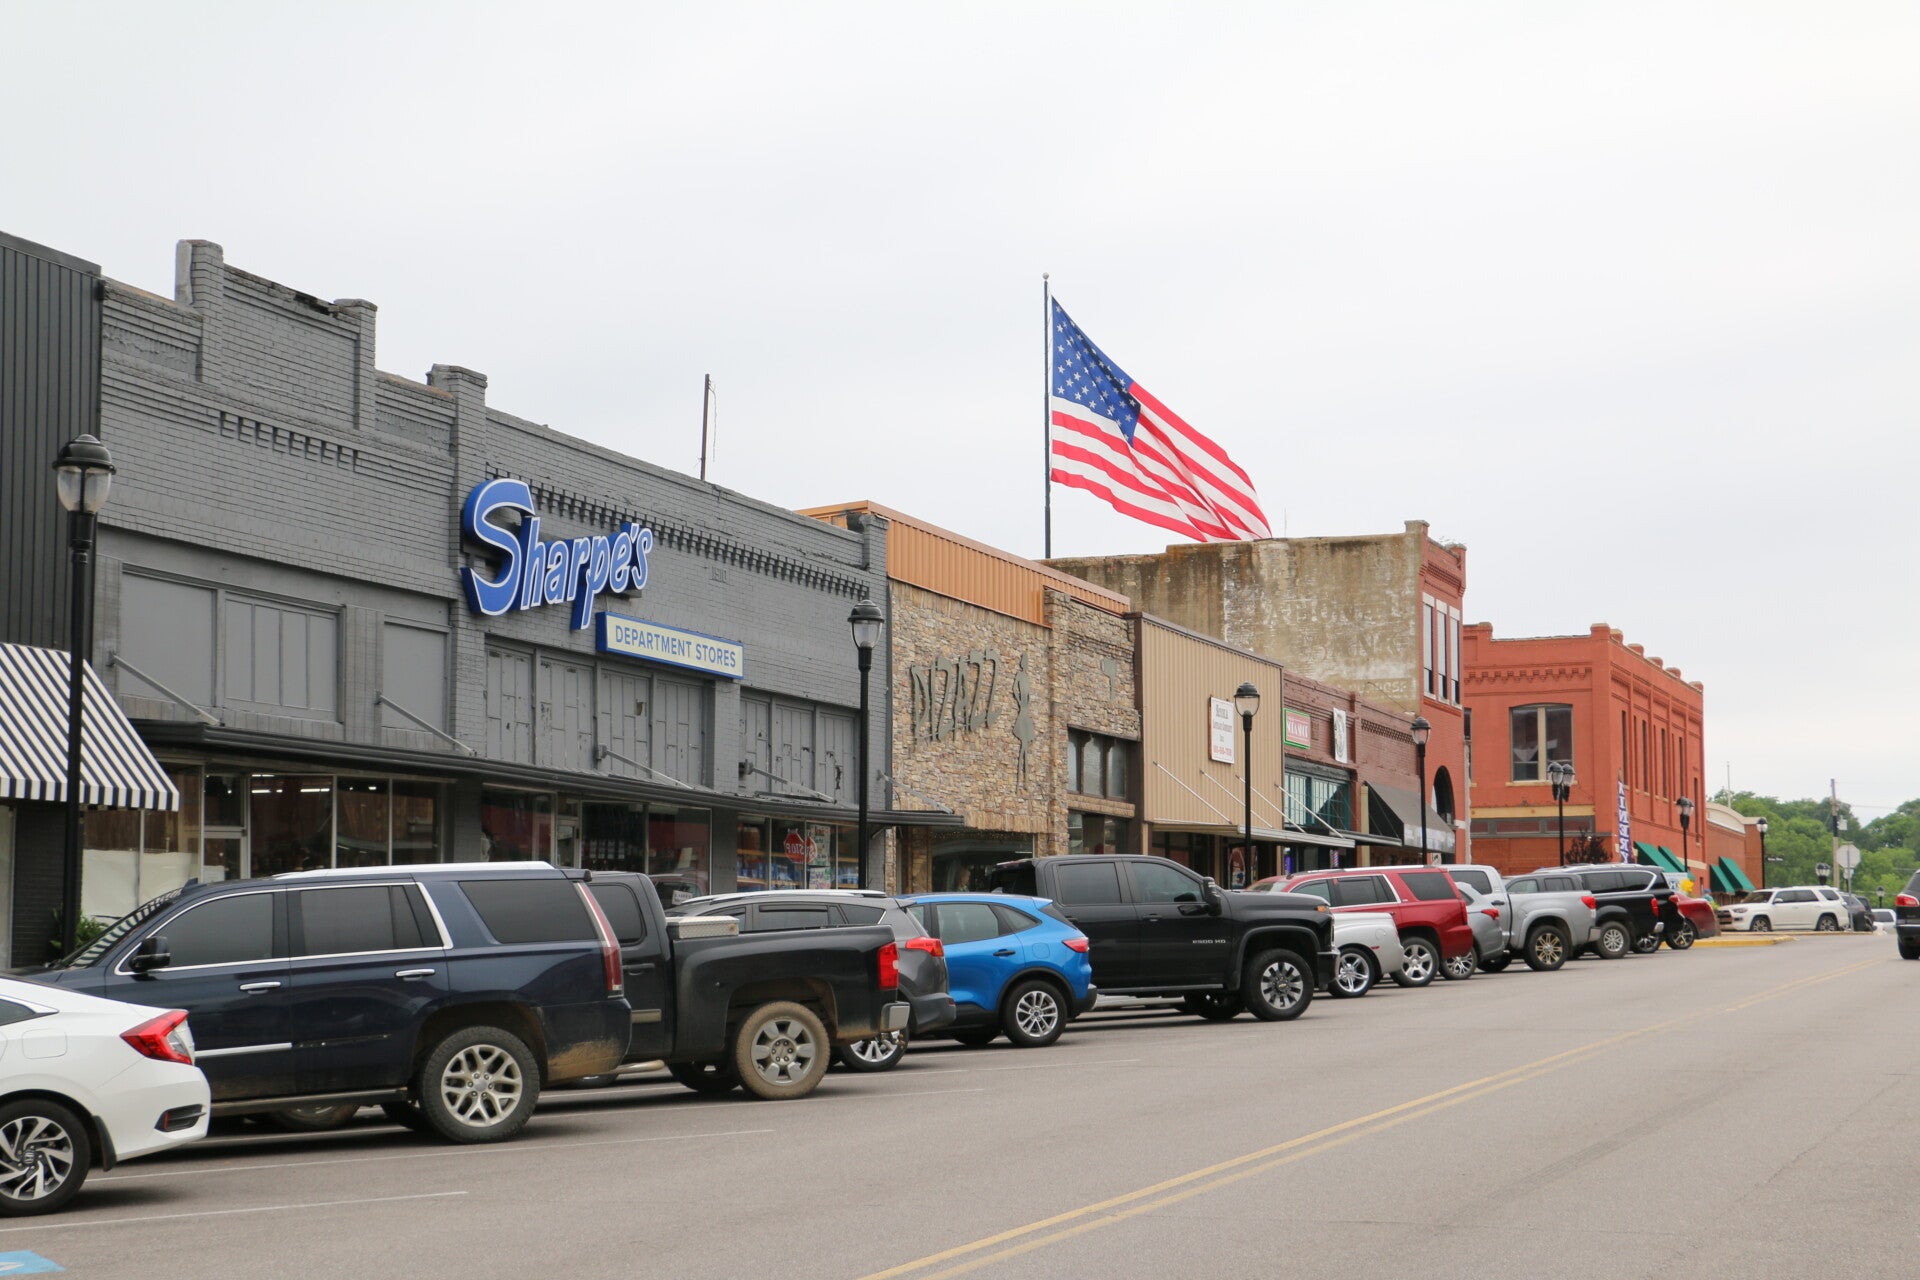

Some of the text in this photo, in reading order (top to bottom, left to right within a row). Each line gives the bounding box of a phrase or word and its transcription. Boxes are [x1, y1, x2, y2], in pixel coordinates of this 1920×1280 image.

[467, 477, 653, 630] Sharpe's
[615, 625, 736, 668] DEPARTMENT STORES
